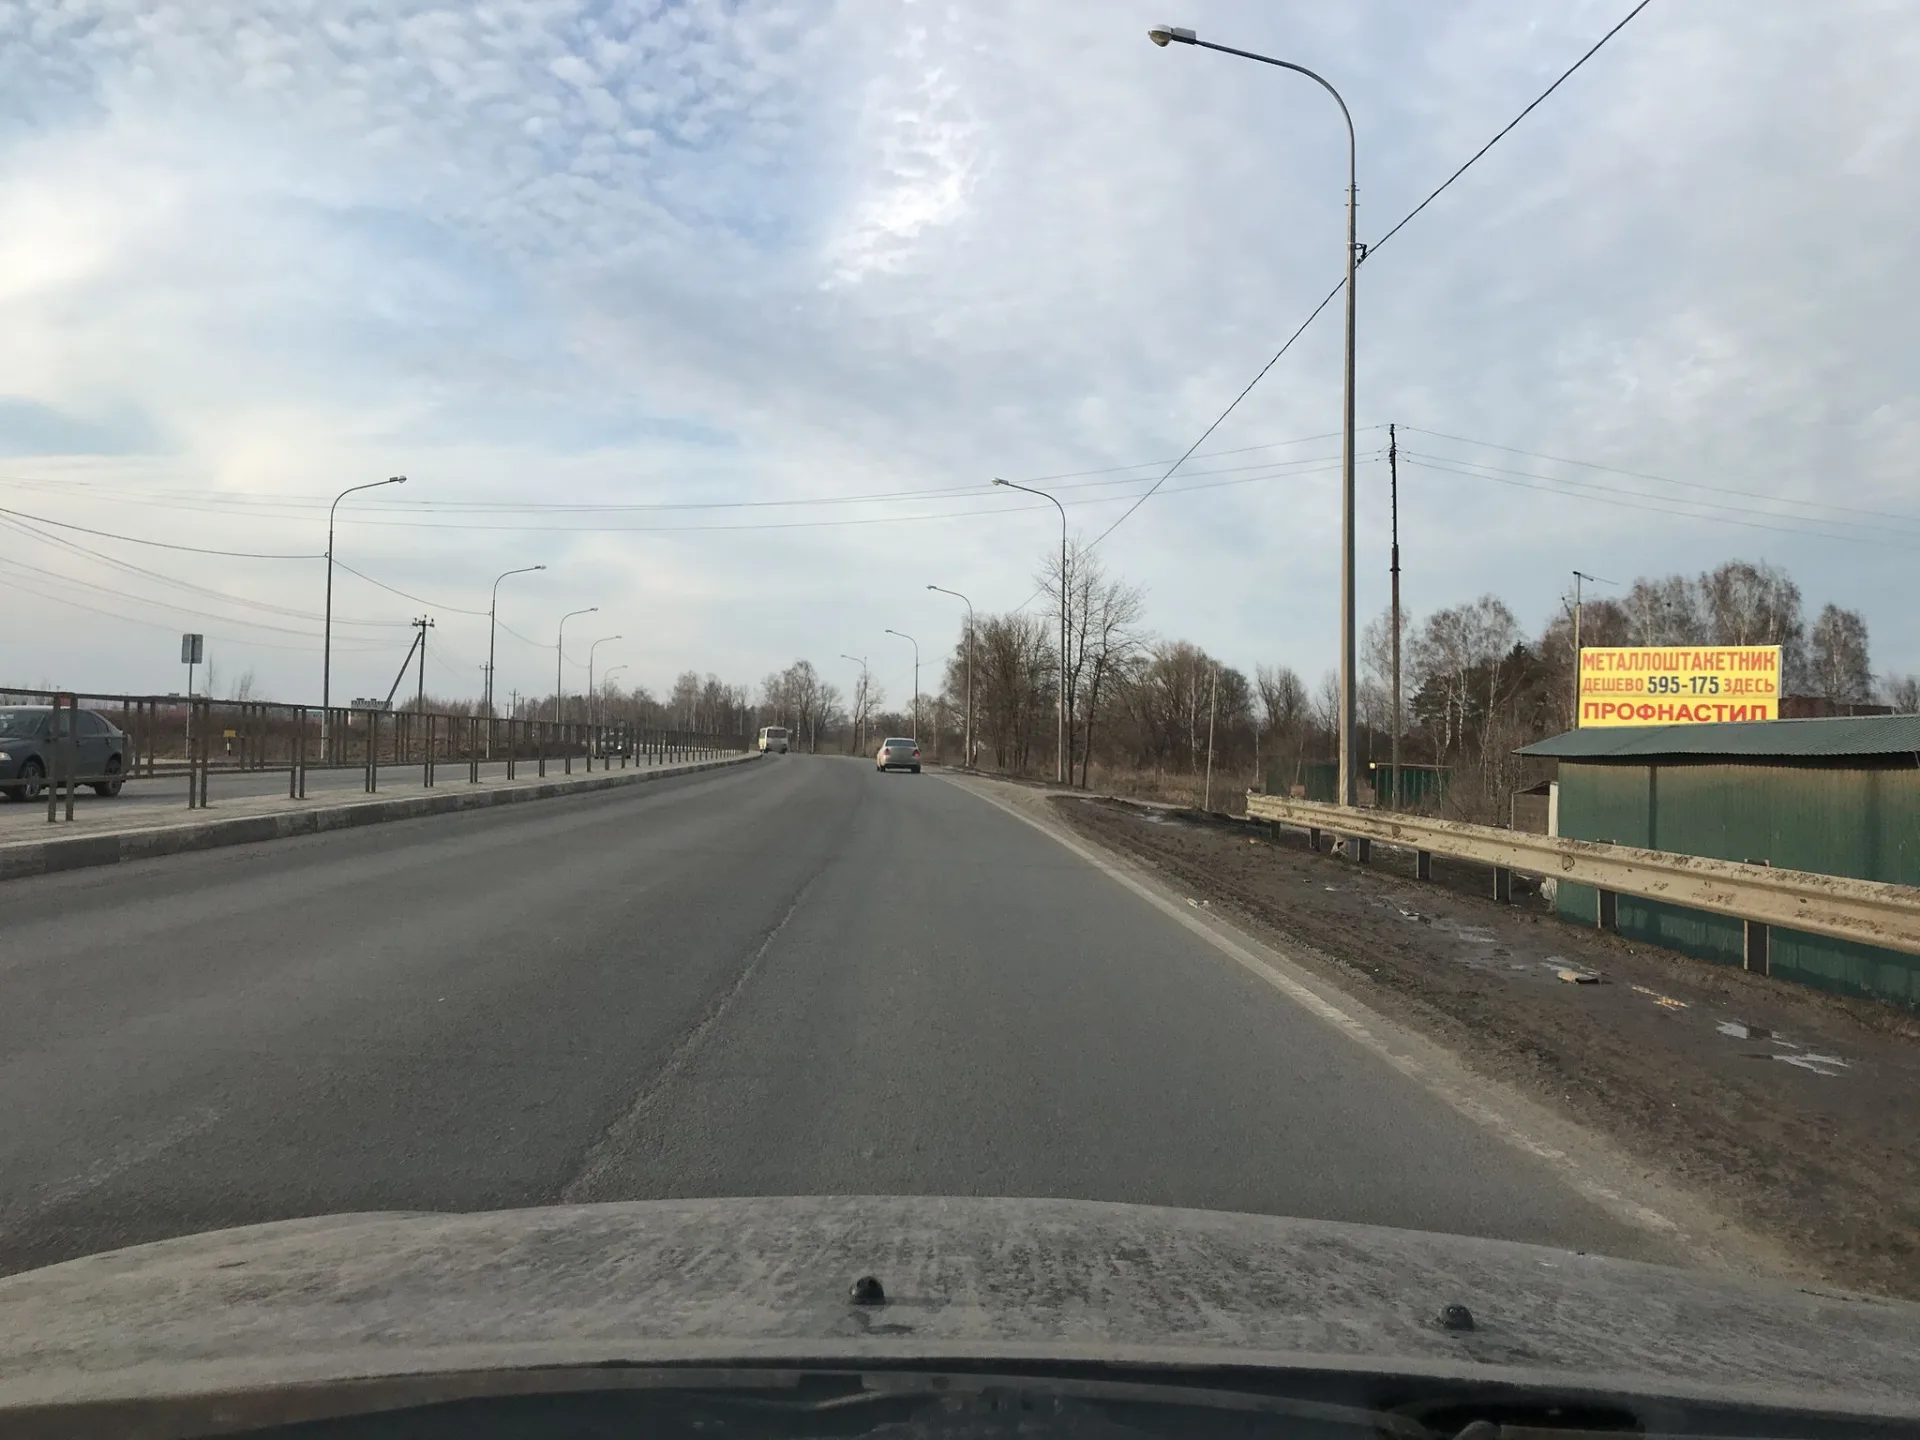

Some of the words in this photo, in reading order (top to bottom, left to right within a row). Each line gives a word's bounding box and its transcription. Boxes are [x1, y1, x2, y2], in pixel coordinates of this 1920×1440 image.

[1582, 651, 1775, 671] МЕТАЛЛОШТАКЕТНИК
[1582, 678, 1643, 693] ДЕШЕВО
[1648, 676, 1720, 694] 595-175
[1723, 678, 1775, 694] ЗДЕСЬ
[1584, 702, 1767, 722] ПРОФНАСТИЛ
